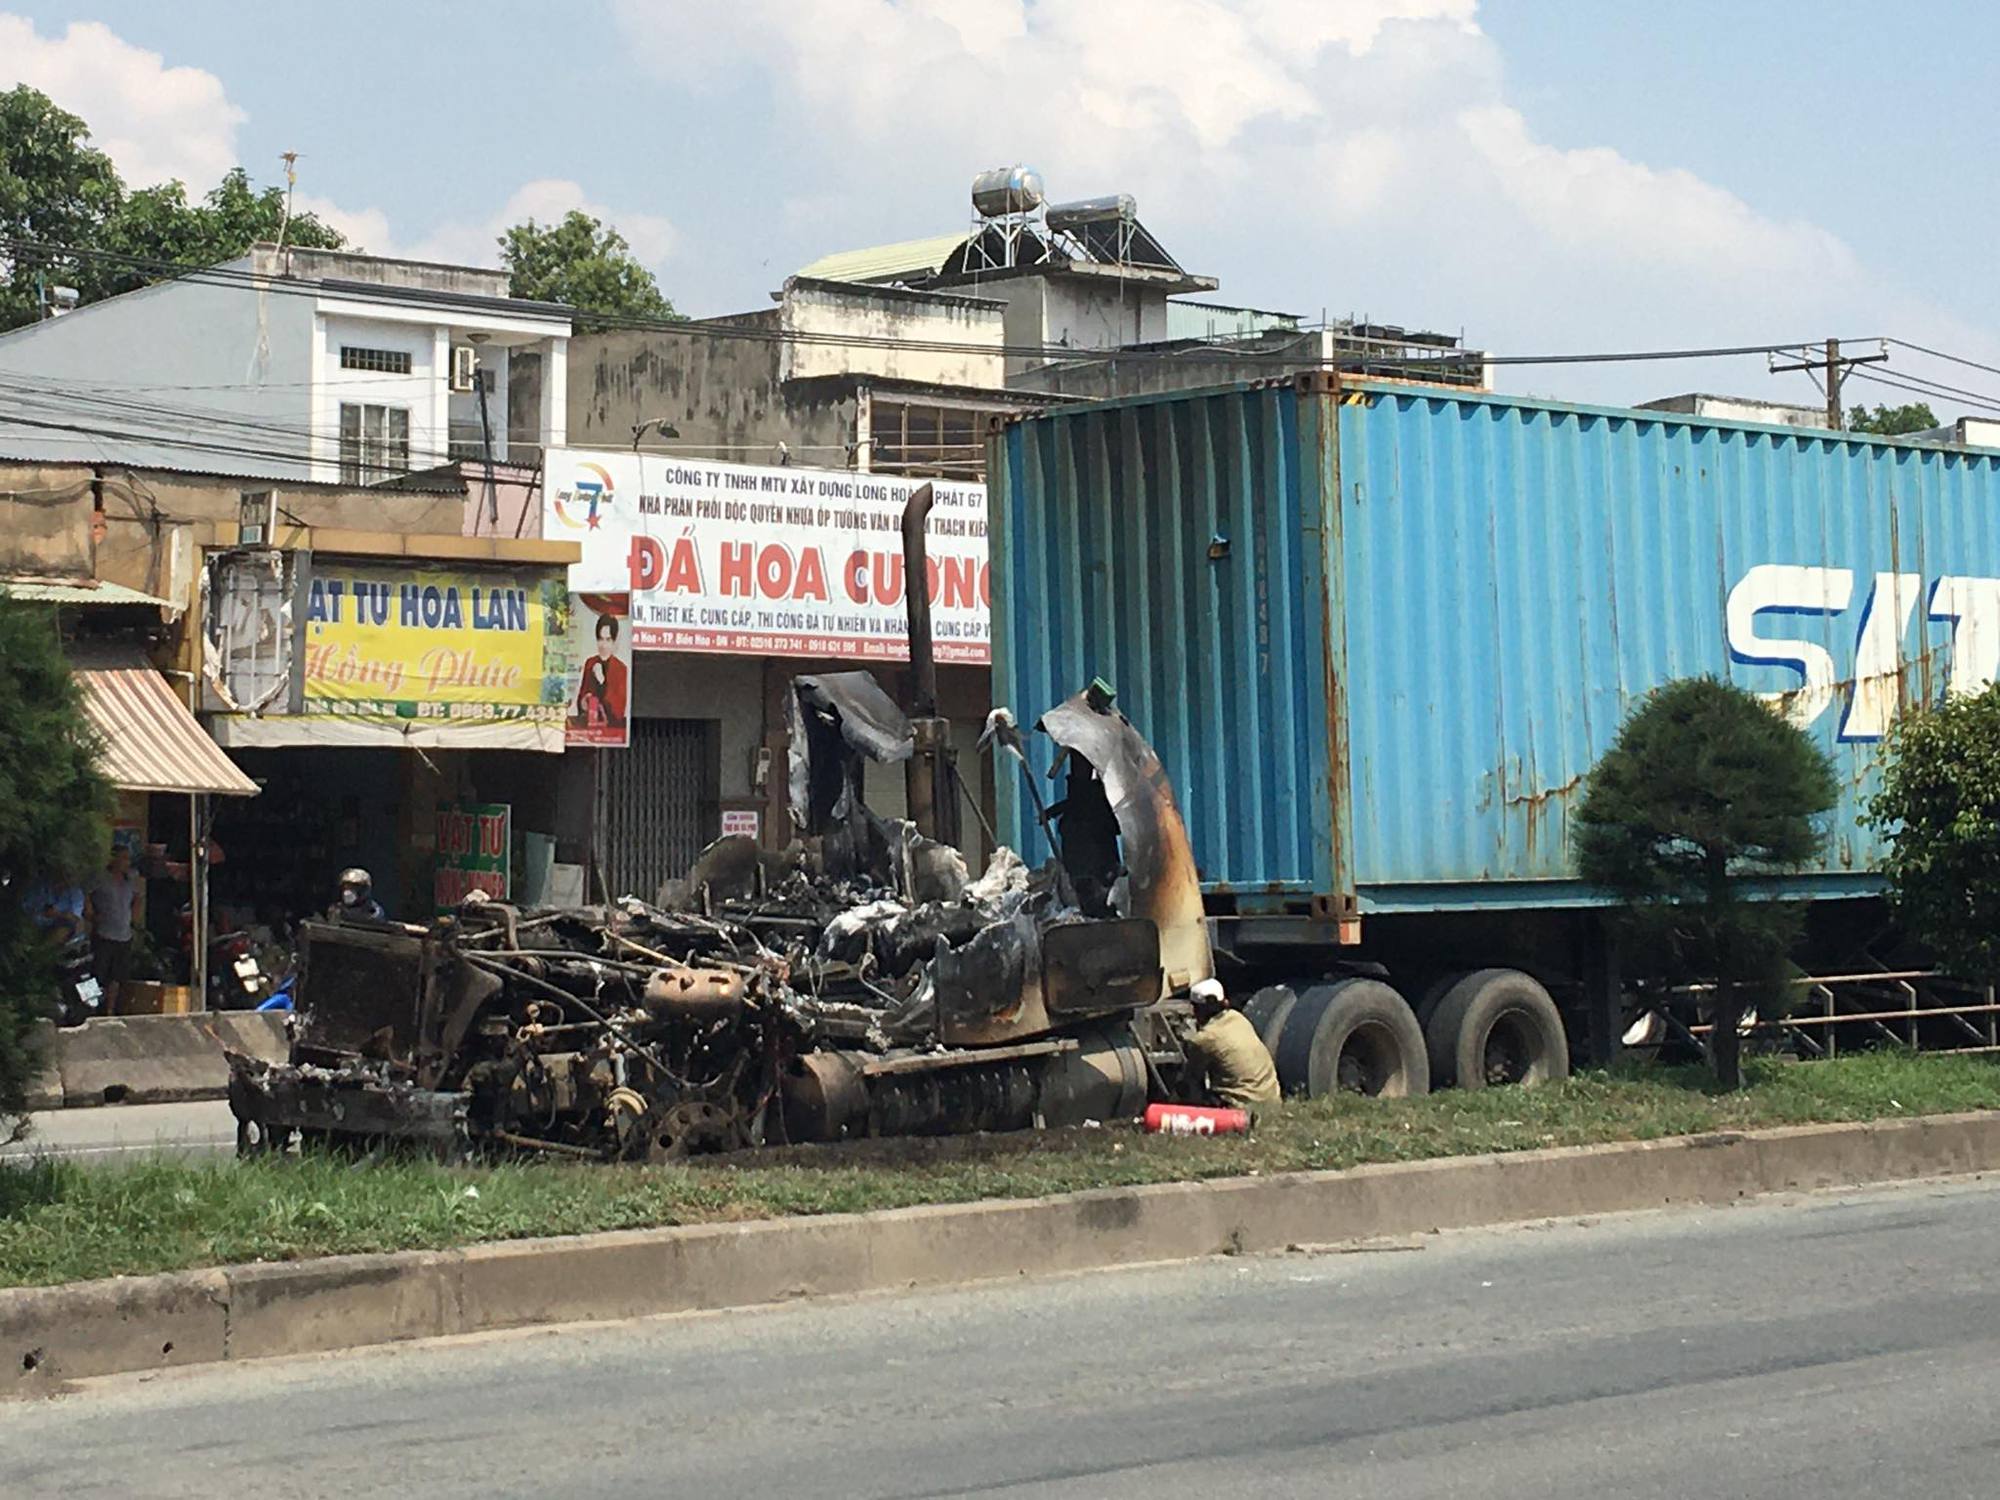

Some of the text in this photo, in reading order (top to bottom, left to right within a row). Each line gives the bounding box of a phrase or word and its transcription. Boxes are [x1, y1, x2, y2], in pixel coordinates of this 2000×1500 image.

[665, 466, 702, 486] CÔNG
[706, 471, 720, 488] TY
[724, 472, 757, 491] TNHH
[761, 476, 787, 494] MTV
[791, 475, 815, 496] XÂY
[855, 484, 887, 501] LONG
[935, 488, 964, 507] PHÁT
[968, 492, 983, 509] G7
[627, 525, 702, 594] ĐÁ
[720, 541, 828, 601] HOA
[400, 584, 463, 629] HOA
[472, 587, 526, 631] LAN
[758, 611, 774, 628] THI
